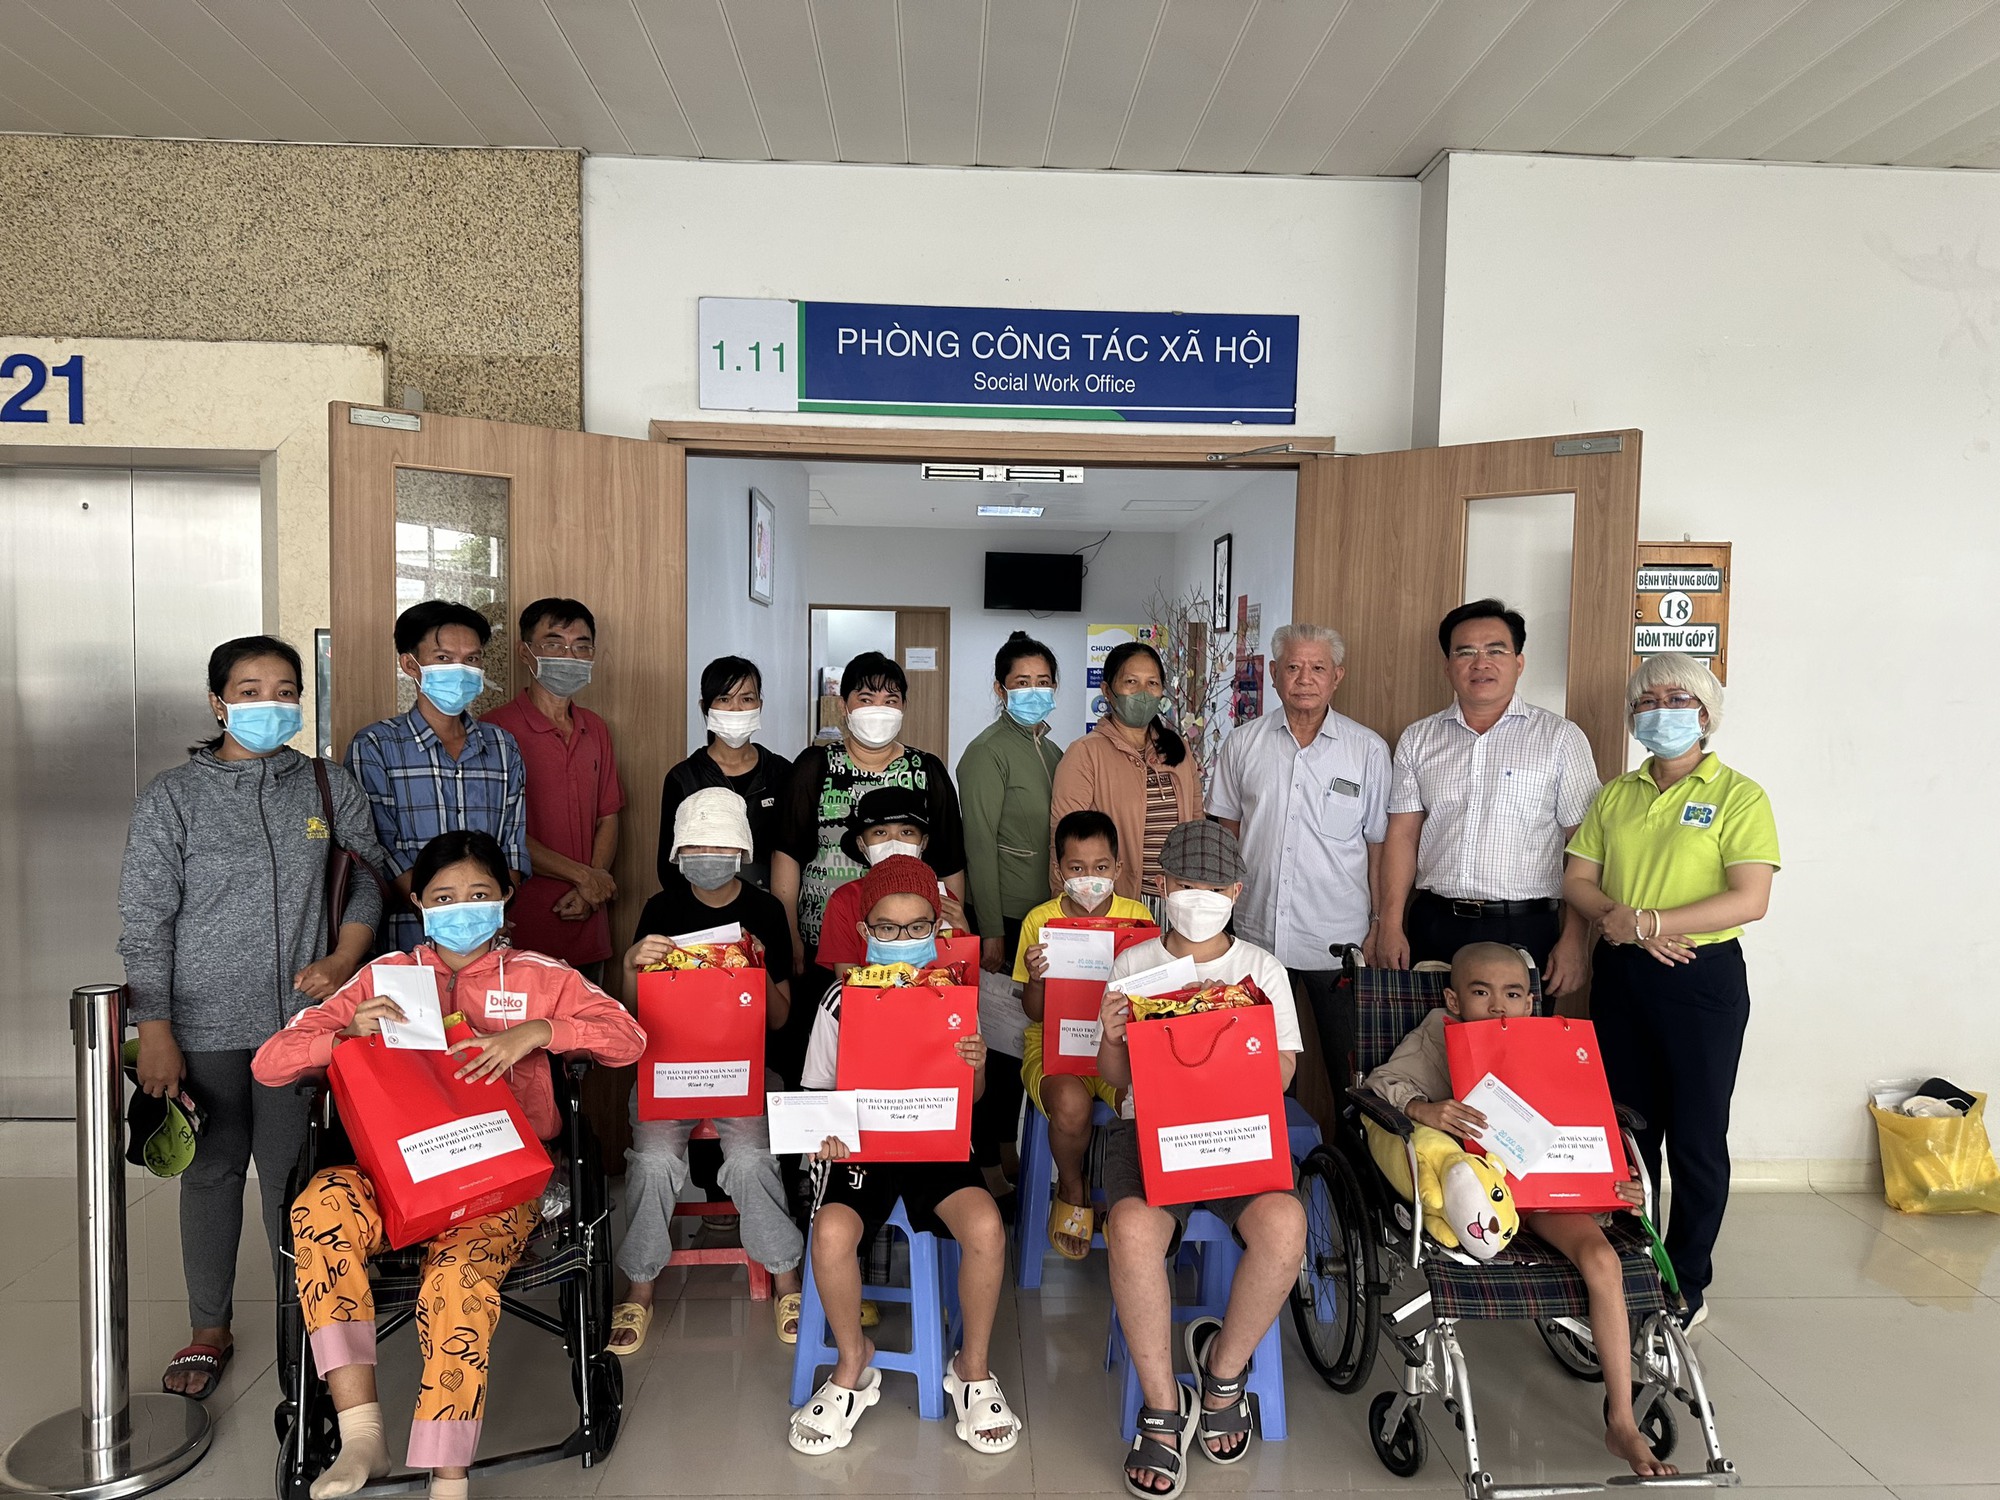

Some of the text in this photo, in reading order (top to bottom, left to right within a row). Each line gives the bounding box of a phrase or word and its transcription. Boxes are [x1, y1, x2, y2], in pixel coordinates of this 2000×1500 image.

[712, 341, 786, 373] 1.11
[838, 323, 1271, 370] PHÒNG CÔNG TÁC XÃ HỘI
[0, 353, 85, 425] 21
[973, 371, 1136, 394] Social Work Office
[1639, 573, 1718, 589] BỆNH VIỆN UNG BƯỚU
[1664, 599, 1689, 620] 18
[1637, 629, 1714, 647] HÒM THƯ GÓP Ý
[490, 995, 522, 1009] beko
